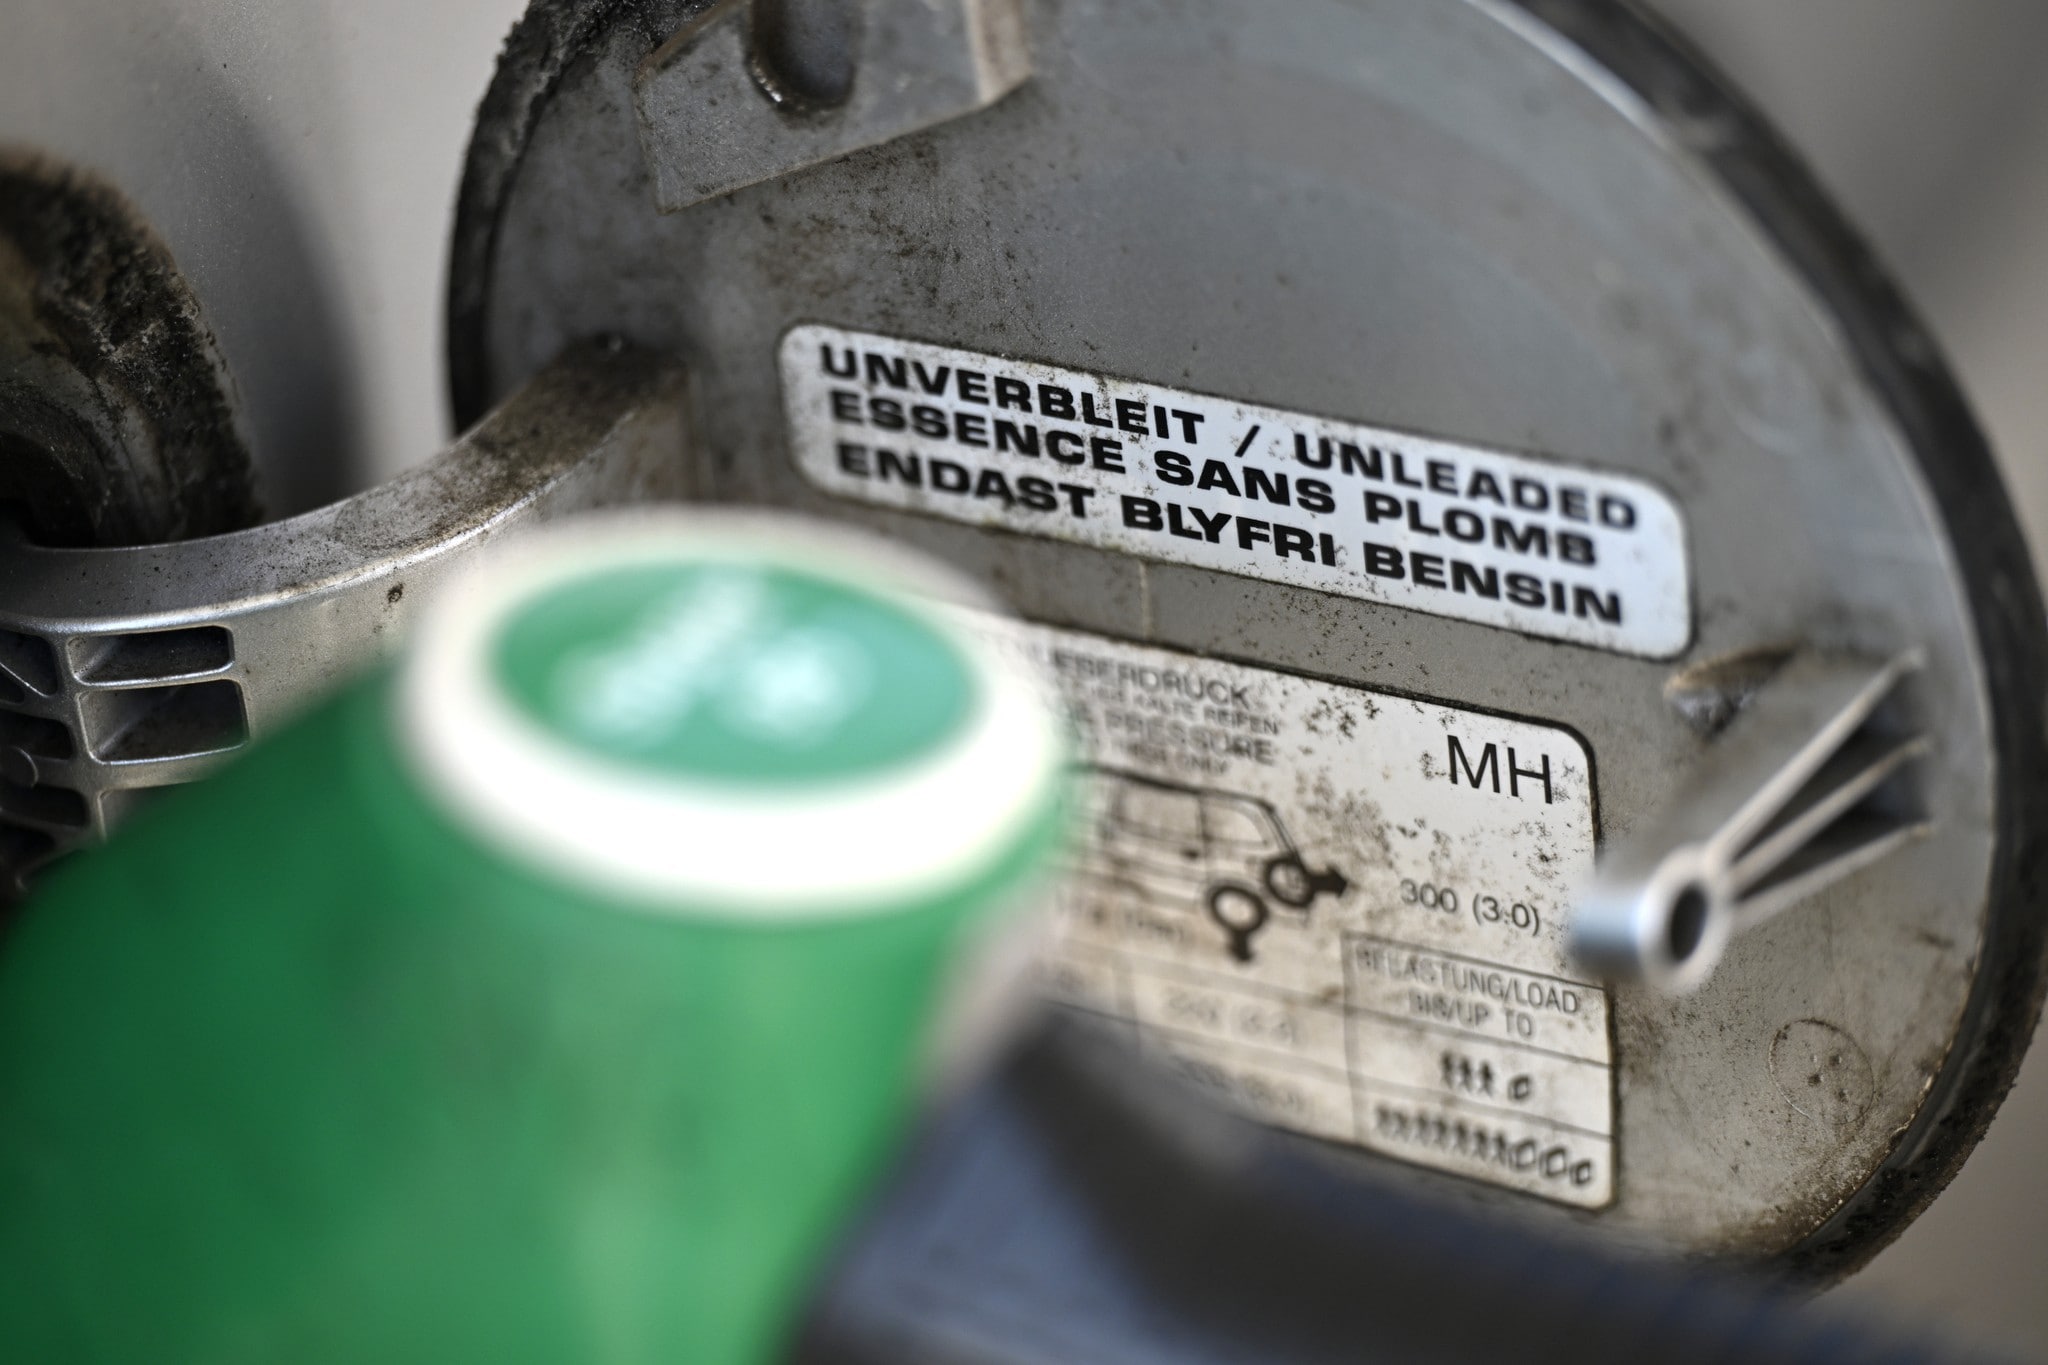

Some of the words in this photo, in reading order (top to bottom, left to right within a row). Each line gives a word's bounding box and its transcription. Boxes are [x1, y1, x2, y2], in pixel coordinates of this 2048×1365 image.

[820, 343, 1205, 445] UNVERBLEIT
[1234, 424, 1261, 458] /
[1295, 433, 1637, 530] UNLEADED
[829, 390, 1126, 474] ESSENCE
[1155, 450, 1336, 514] SANS
[1363, 491, 1597, 567] PLOMB
[836, 442, 1095, 518] ENDAST
[1121, 494, 1337, 567] BLYFRI
[1363, 542, 1623, 625] BENSIN
[1447, 734, 1553, 805] MH
[1400, 878, 1458, 914] 300
[1504, 1008, 1534, 1038] TO
